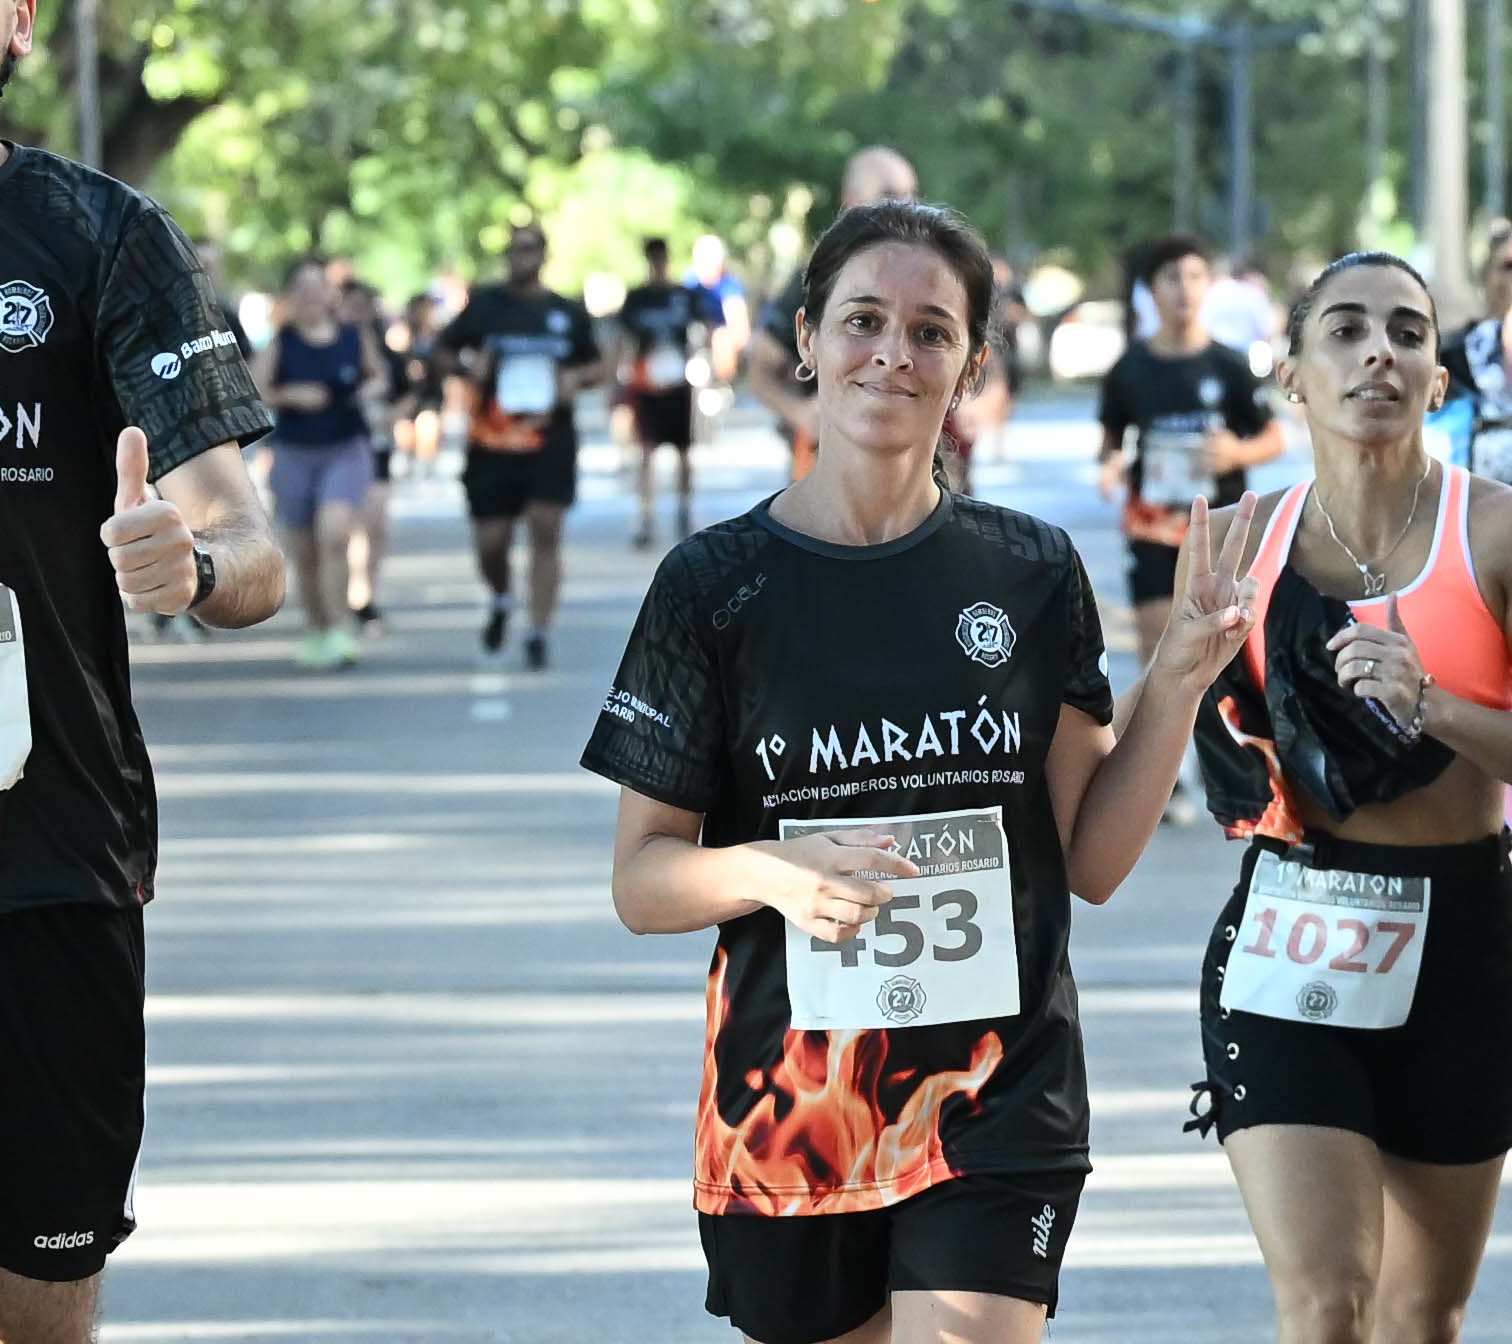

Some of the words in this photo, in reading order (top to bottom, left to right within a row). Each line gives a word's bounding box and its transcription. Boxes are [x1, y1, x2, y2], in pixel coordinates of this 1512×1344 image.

[3, 301, 32, 325] 27
[1, 467, 55, 481] ROSARIO
[976, 622, 999, 643] 27
[809, 694, 1021, 773] MARATÓN
[821, 775, 898, 800] BOMBEROS
[901, 769, 989, 790] VOLUNTARIOS
[888, 824, 975, 860] RATÓN
[920, 862, 960, 876] UNTARIOS
[962, 857, 999, 872] ROSARIO
[1243, 907, 1416, 975] 1027
[892, 989, 912, 1007] 27
[34, 1230, 95, 1249] adidas
[1031, 1204, 1056, 1258] nike
